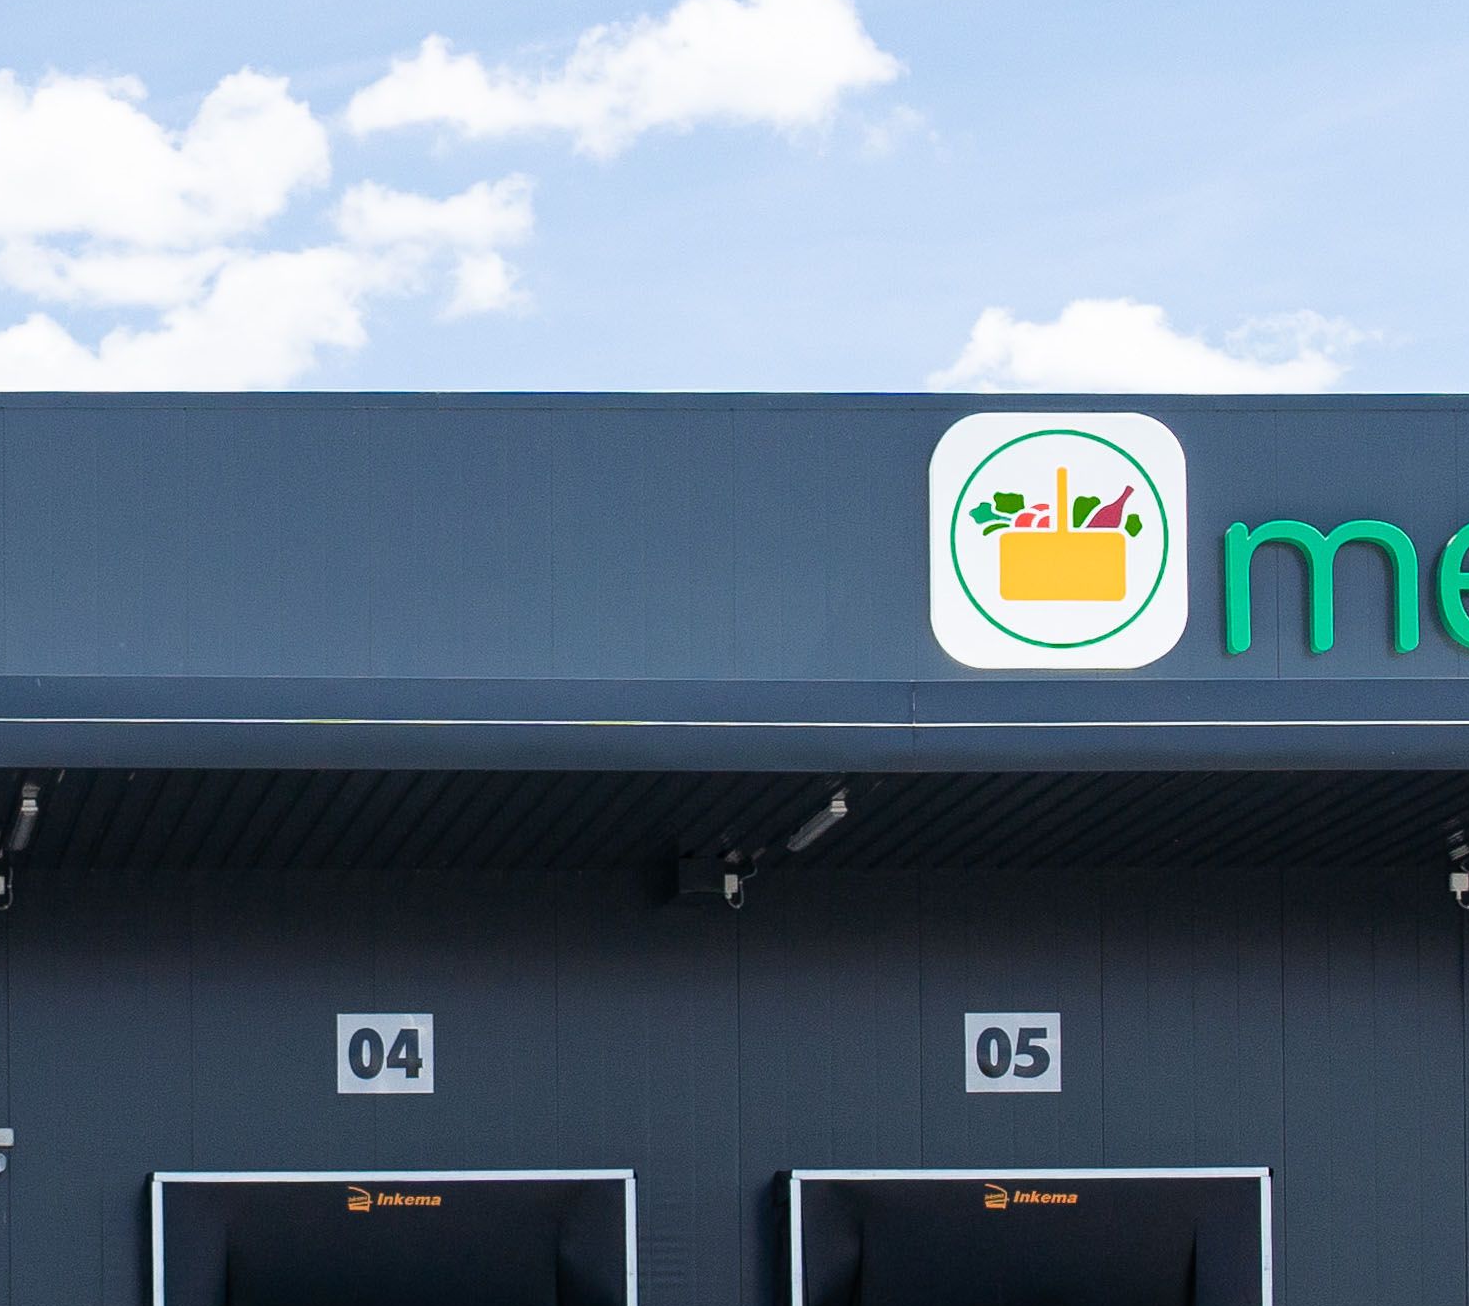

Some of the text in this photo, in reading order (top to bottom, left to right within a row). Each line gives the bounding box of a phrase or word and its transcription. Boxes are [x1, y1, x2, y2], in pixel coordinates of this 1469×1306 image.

[348, 1027, 423, 1080] 04
[976, 1027, 1051, 1079] 05
[376, 1192, 442, 1208] Inkema
[1013, 1190, 1078, 1205] Inkema
